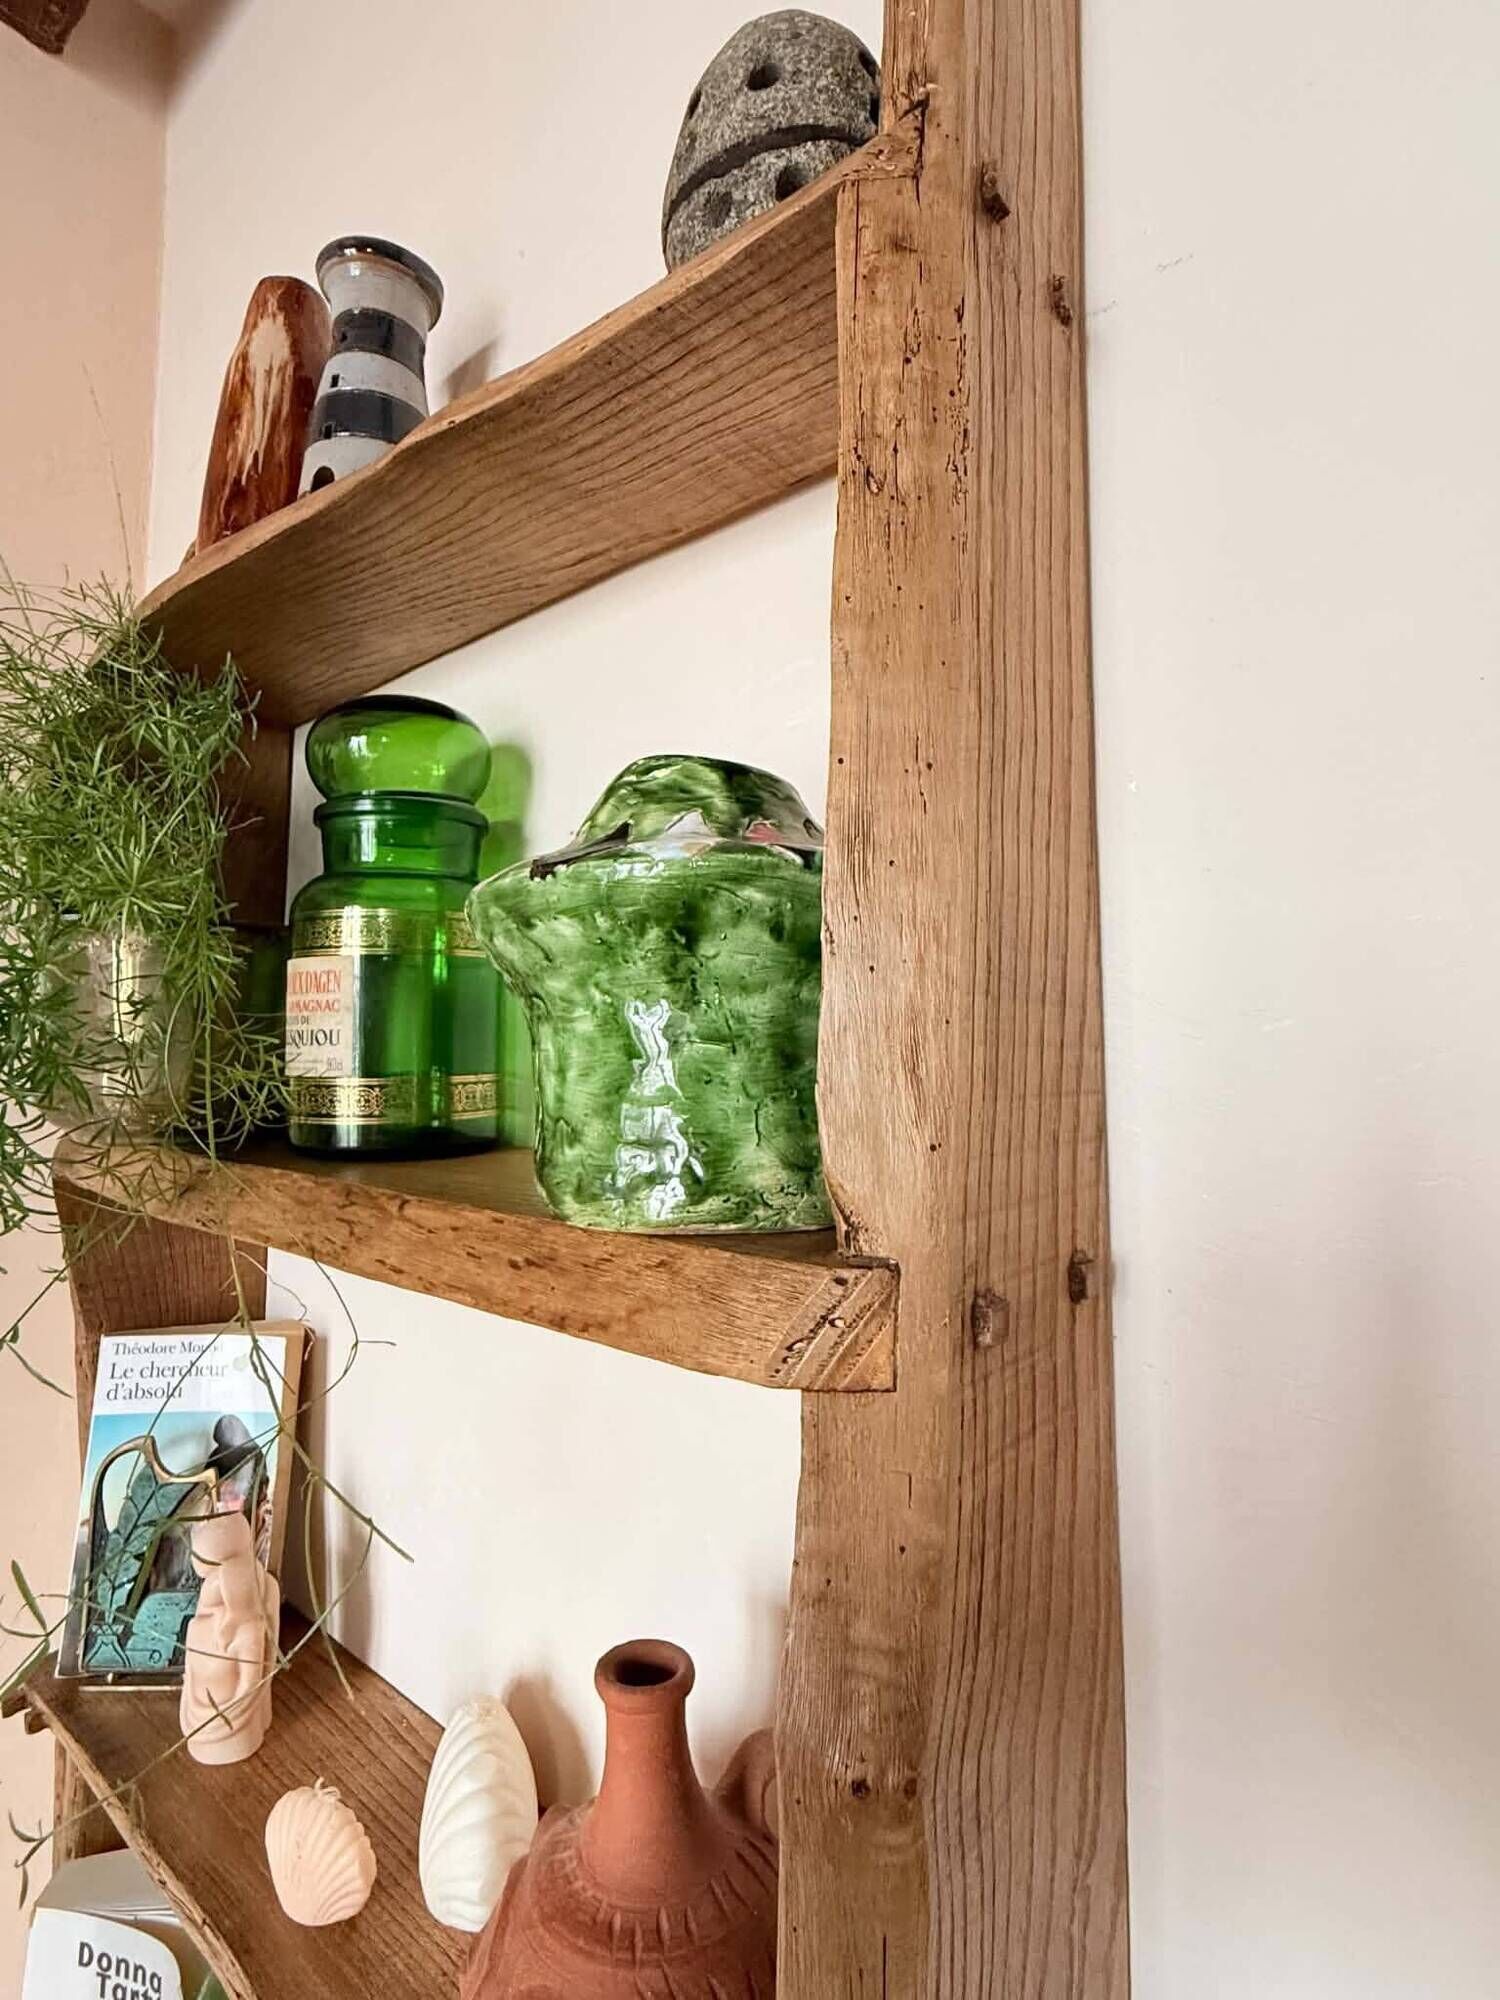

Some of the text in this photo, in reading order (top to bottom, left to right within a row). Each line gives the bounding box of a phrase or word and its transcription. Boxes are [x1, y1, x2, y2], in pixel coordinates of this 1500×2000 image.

[112, 1341, 177, 1356] Théodore
[110, 1360, 228, 1380] Le chercheur
[78, 1940, 162, 1993] Donna
[96, 1971, 162, 2000] Tart
